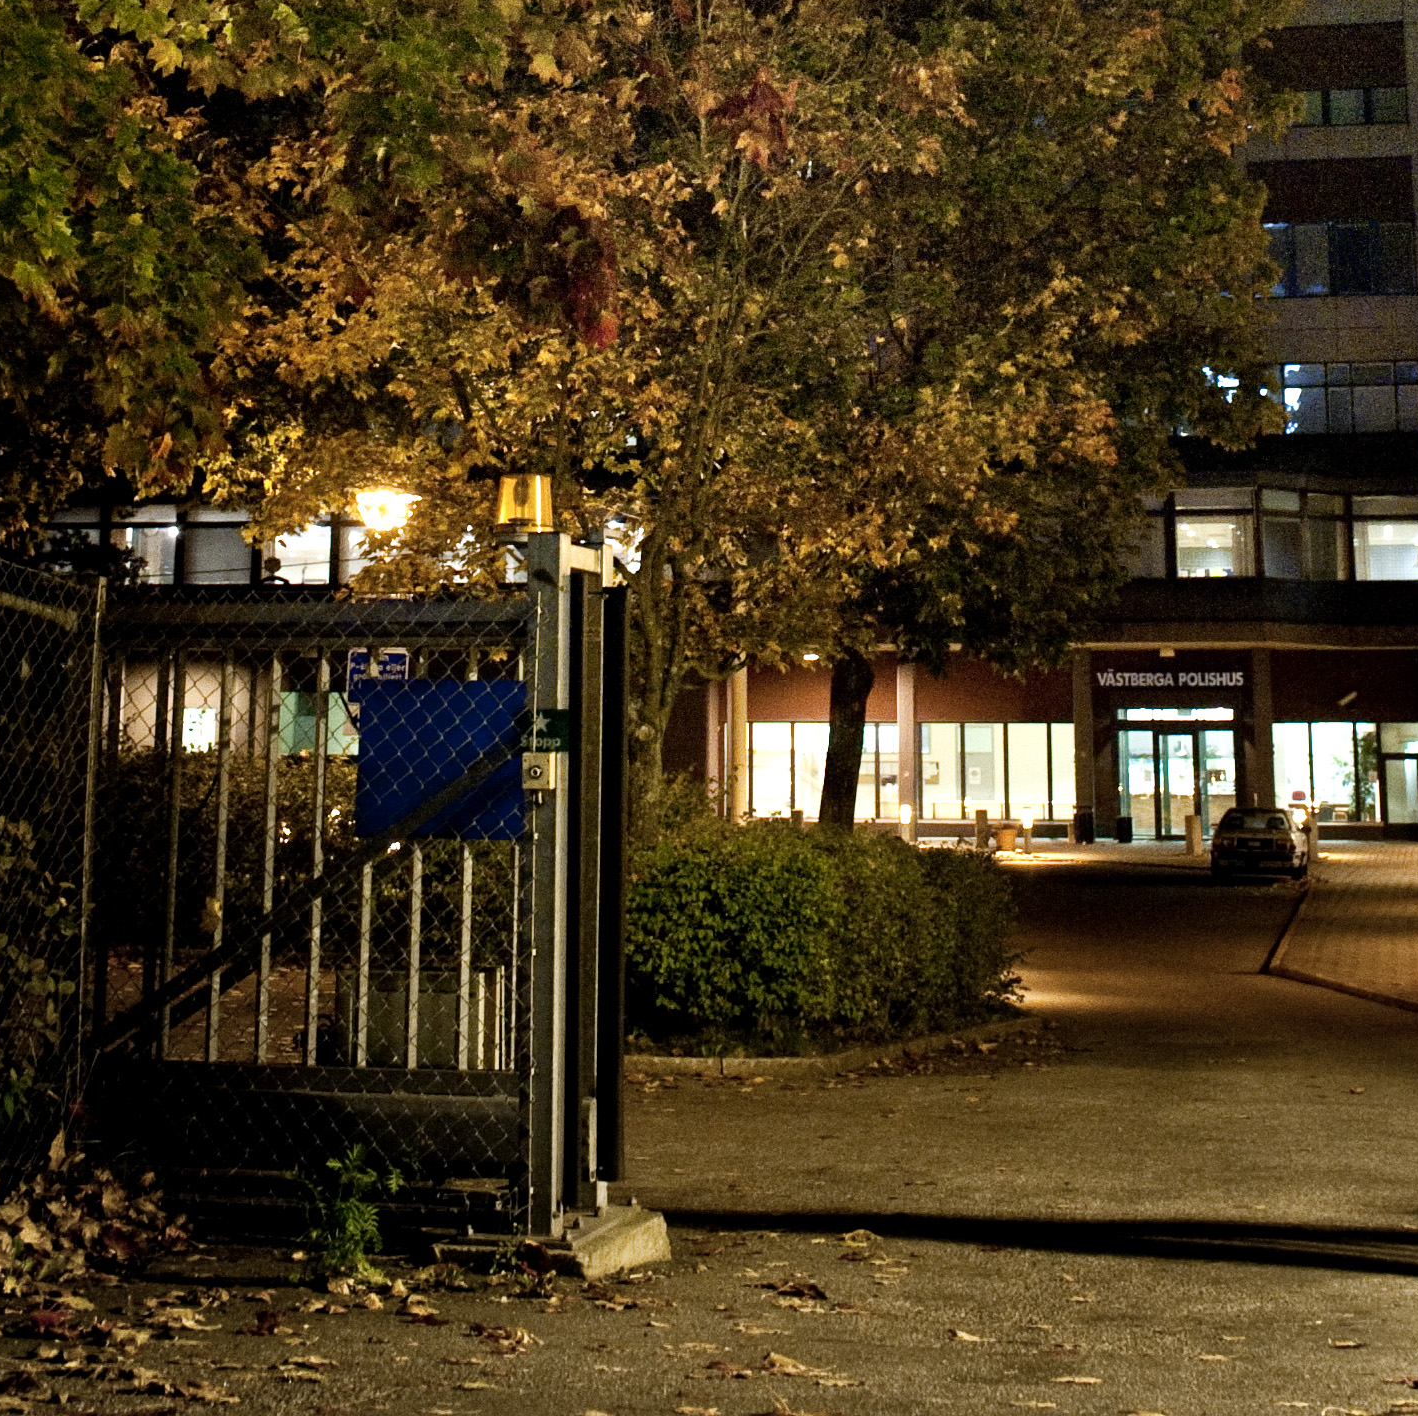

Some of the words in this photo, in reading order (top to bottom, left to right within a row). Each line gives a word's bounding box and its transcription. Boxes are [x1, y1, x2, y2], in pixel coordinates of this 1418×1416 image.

[1097, 668, 1174, 687] VÄSTBERGA
[1178, 671, 1244, 687] POLISHUS
[520, 734, 561, 750] Stopp
